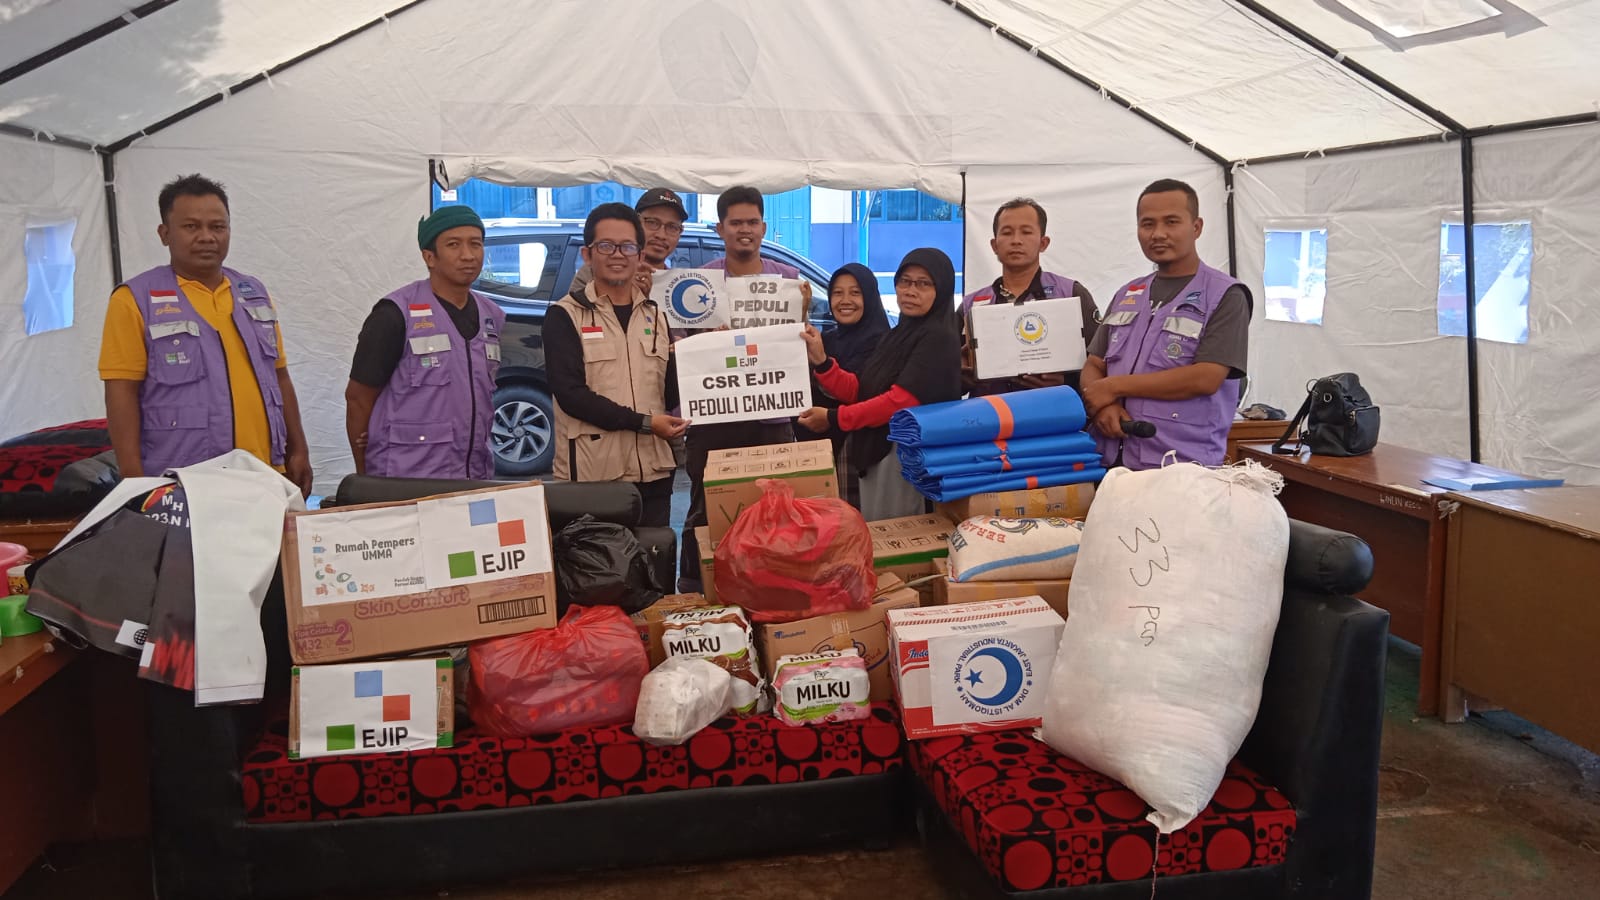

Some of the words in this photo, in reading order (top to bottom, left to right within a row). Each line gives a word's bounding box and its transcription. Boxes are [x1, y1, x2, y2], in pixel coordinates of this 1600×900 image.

[749, 281, 778, 294] 023
[734, 299, 789, 312] PEDULI
[739, 357, 758, 367] EJIP
[702, 375, 741, 389] CSR
[745, 370, 786, 386] EJIP
[688, 396, 739, 417] PEDULI
[742, 390, 805, 413] CIANJUR
[335, 540, 370, 553] Rumah
[371, 537, 415, 551] Pempers
[362, 548, 393, 561] UMMA
[1117, 517, 1170, 587] 33
[481, 549, 526, 575] EJIP
[357, 600, 395, 616] Skin
[672, 608, 727, 620] MILKU
[668, 636, 721, 657] MILKU
[957, 637, 996, 662] INDUSTRIAL
[996, 637, 1027, 658] JAKARTA
[789, 651, 842, 663] MILKU
[953, 663, 963, 684] PARK
[1022, 658, 1033, 677] EAST
[796, 680, 851, 705] MILKU
[1014, 688, 1029, 706] DKM
[960, 693, 1003, 716] ISTIQOMAH
[1003, 702, 1014, 712] AL
[362, 726, 409, 749] EJIP
